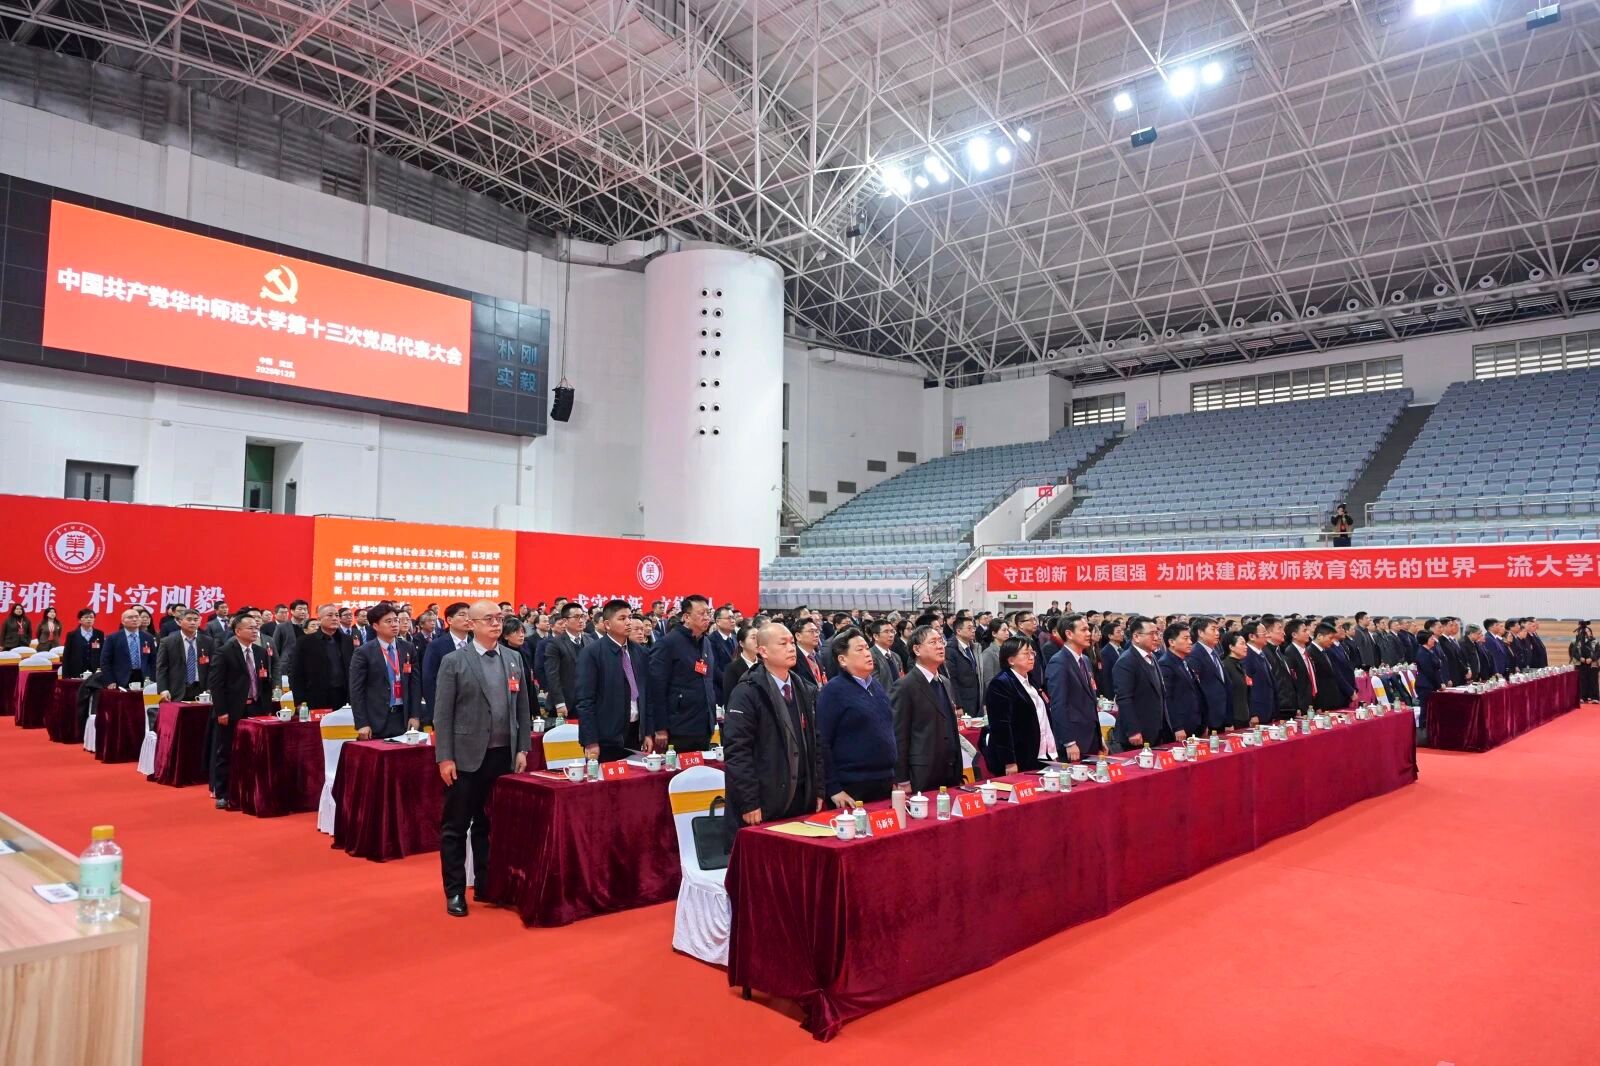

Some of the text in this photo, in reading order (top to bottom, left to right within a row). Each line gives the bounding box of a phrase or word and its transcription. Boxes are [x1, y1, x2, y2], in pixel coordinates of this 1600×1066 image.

[57, 268, 463, 366] 中国共产党华中师范大学第十三次党员代表大会
[1003, 553, 1600, 584] 守正创新 以质图强 为加快建成教师教育领先的世界一流大学
[87, 583, 226, 614] 朴实刚毅
